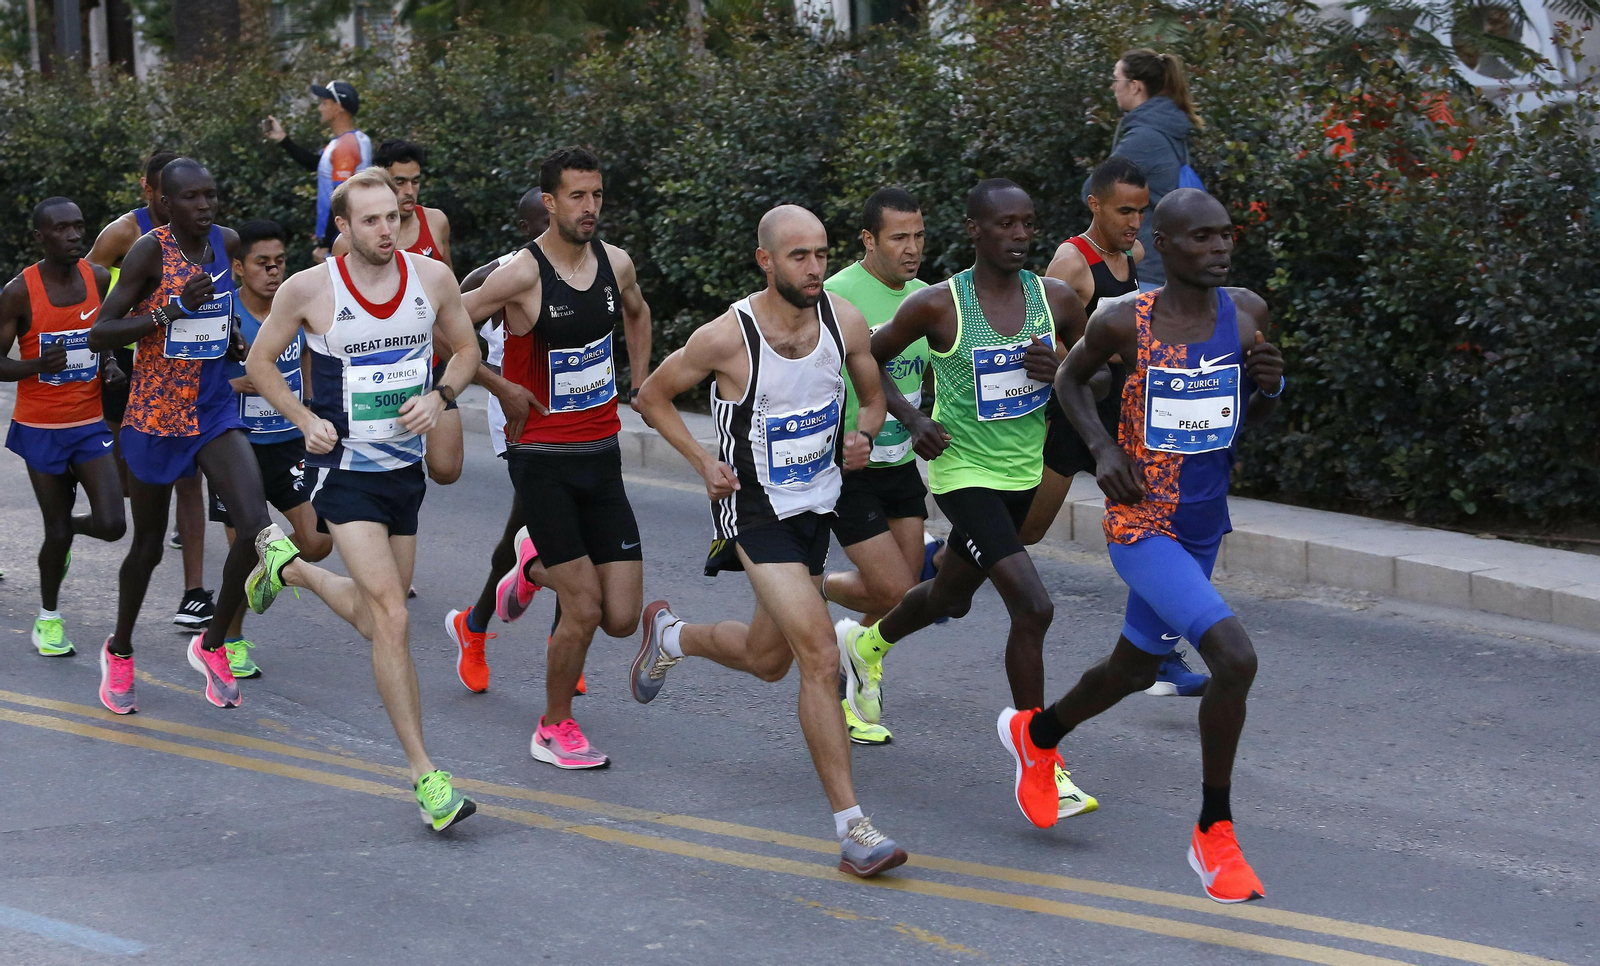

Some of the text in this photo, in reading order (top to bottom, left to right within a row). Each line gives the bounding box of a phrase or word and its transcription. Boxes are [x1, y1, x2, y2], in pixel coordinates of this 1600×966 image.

[198, 303, 223, 311] ZURICH
[337, 314, 356, 322] adidas
[195, 333, 210, 342] TOO
[344, 333, 428, 354] GREAT BRITAIN
[814, 356, 836, 368] adidas
[1009, 351, 1028, 362] ZUR
[387, 369, 418, 380] ZURICH
[569, 378, 606, 394] BOULAME
[1187, 378, 1219, 389] ZURICH
[1004, 384, 1034, 397] KOECH
[375, 392, 407, 408] 5006
[259, 409, 281, 417] SOLA
[800, 413, 827, 427] ZURICH
[1178, 420, 1210, 429] PEACE
[785, 456, 795, 465] EL
